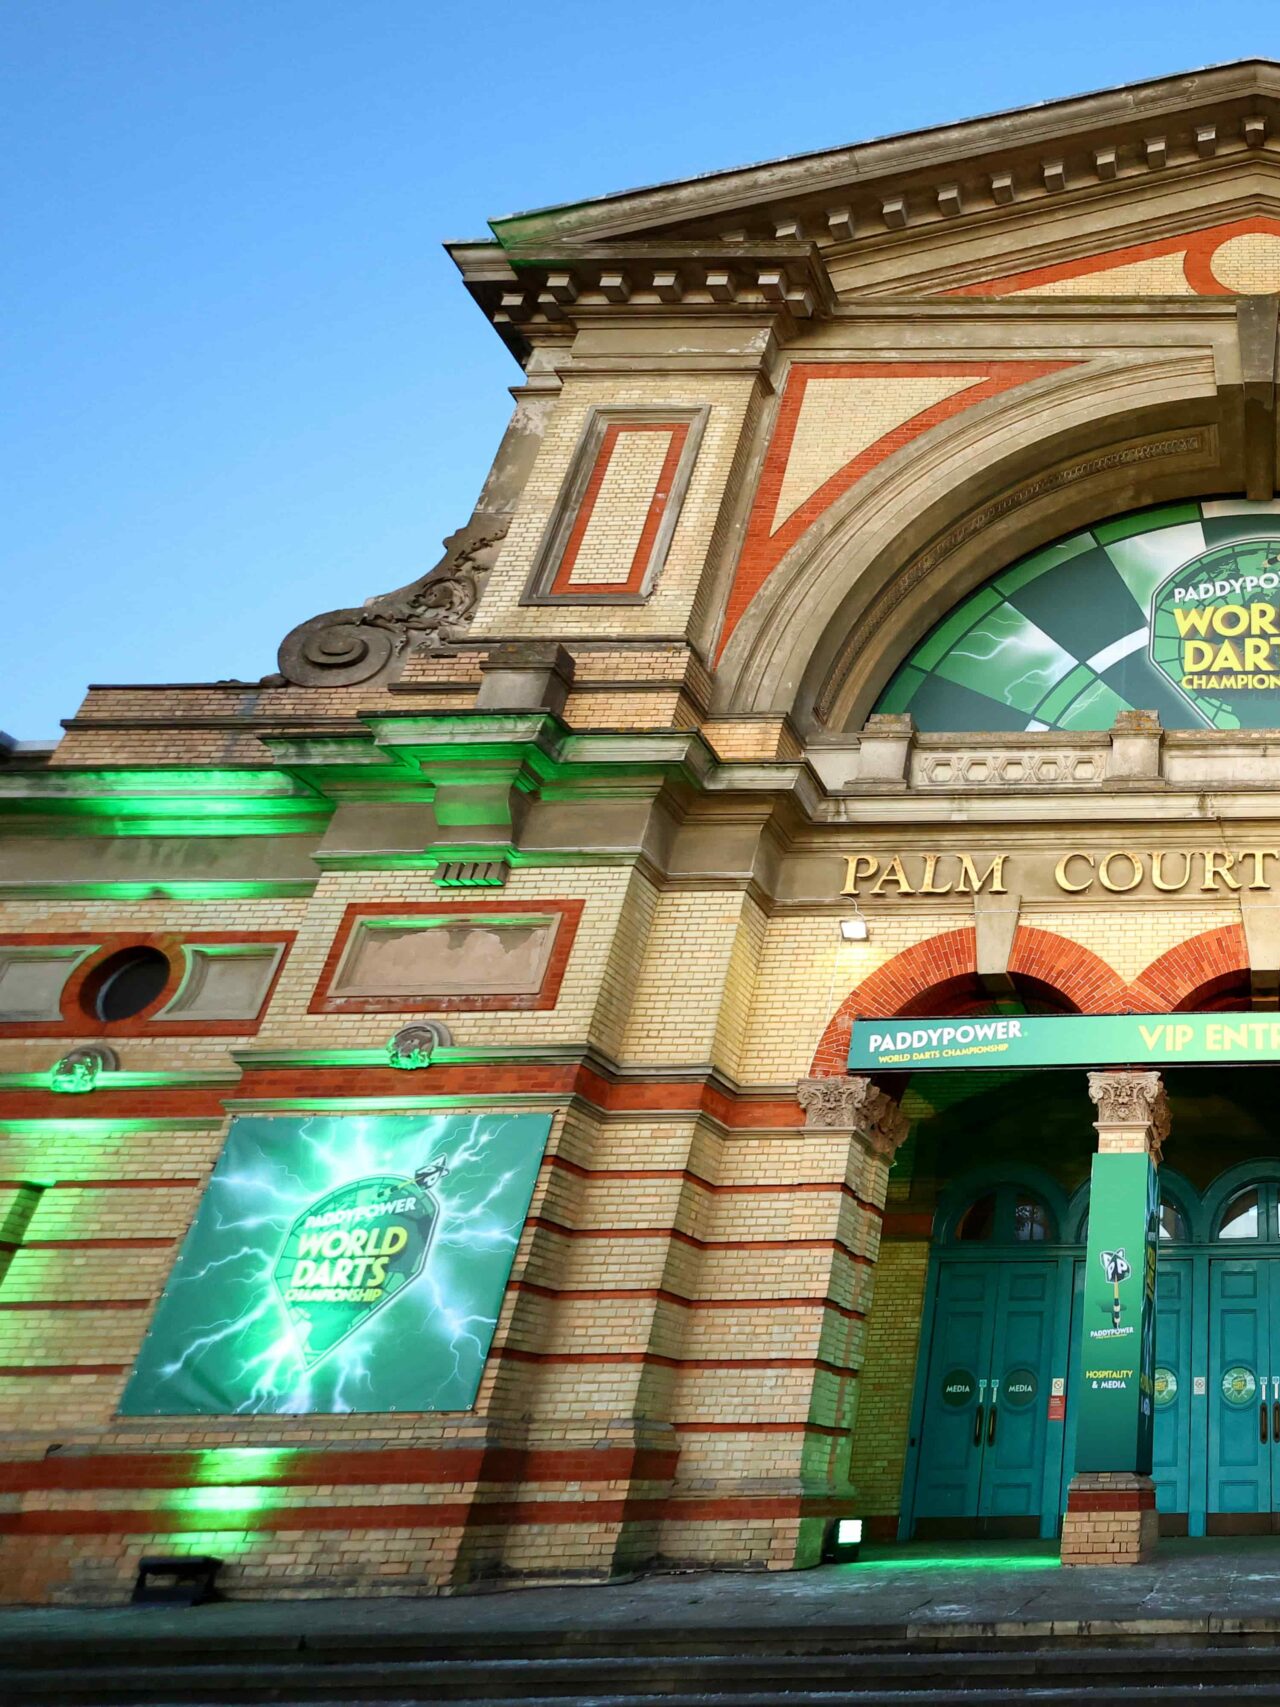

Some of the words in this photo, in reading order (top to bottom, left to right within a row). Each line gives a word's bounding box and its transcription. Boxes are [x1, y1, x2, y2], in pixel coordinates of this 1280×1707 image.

[839, 853, 1010, 896] PALM
[1054, 850, 1280, 892] COURT
[1138, 1024, 1194, 1052] VIP
[878, 1053, 911, 1064] WORLD
[912, 1050, 940, 1061] DARTS
[942, 1043, 1009, 1058] CHAMPIONSHIP
[303, 1197, 417, 1229] PADDYPOWER
[297, 1226, 408, 1259] WORLD
[290, 1256, 390, 1288] DARTS
[284, 1288, 383, 1303] CHAMPIONSHIP
[1090, 1326, 1134, 1338] PADDYPOWER
[1086, 1370, 1133, 1379] HOSPITALITY
[946, 1385, 971, 1393] MEDIA
[1008, 1384, 1033, 1393] MEDIA
[1091, 1381, 1099, 1389] &
[1100, 1381, 1126, 1389] MEDIA
